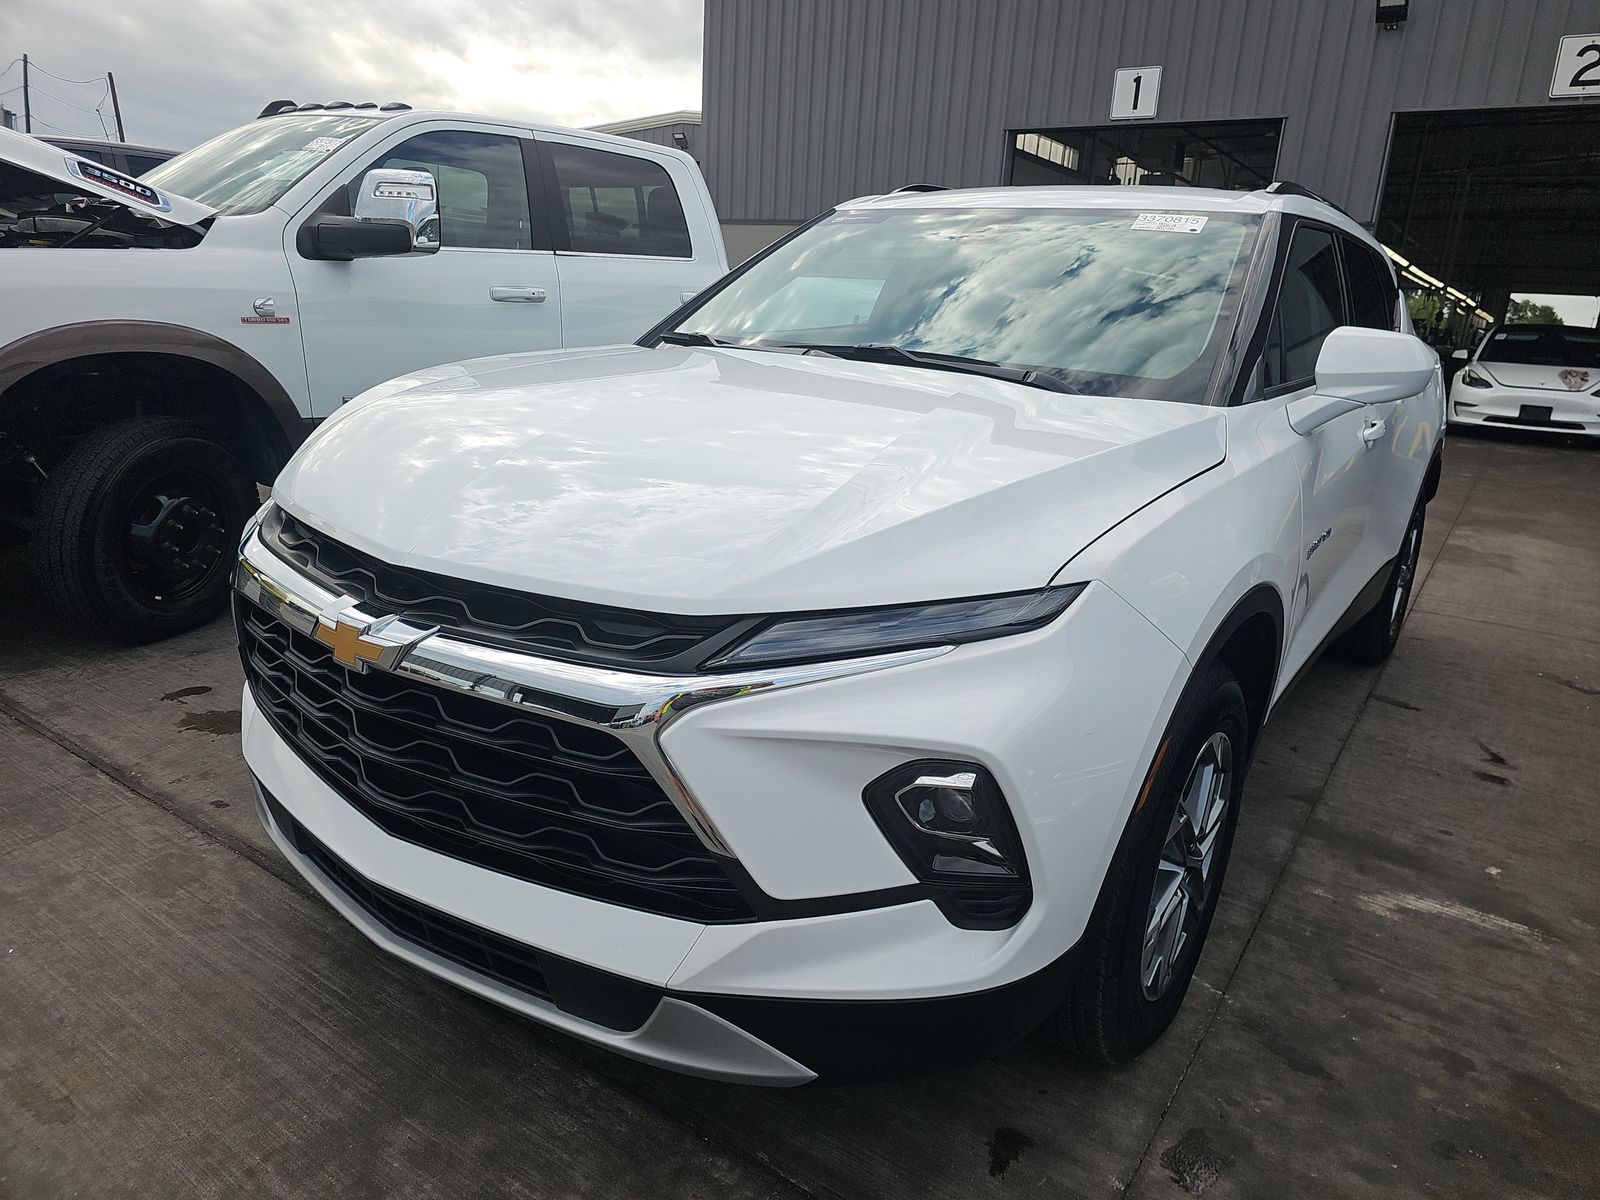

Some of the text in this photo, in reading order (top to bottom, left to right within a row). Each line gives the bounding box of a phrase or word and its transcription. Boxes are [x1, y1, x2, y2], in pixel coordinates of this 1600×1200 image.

[1569, 44, 1600, 87] 2
[1132, 75, 1142, 111] 1
[83, 165, 152, 197] 3500
[1138, 214, 1200, 225] 3370815
